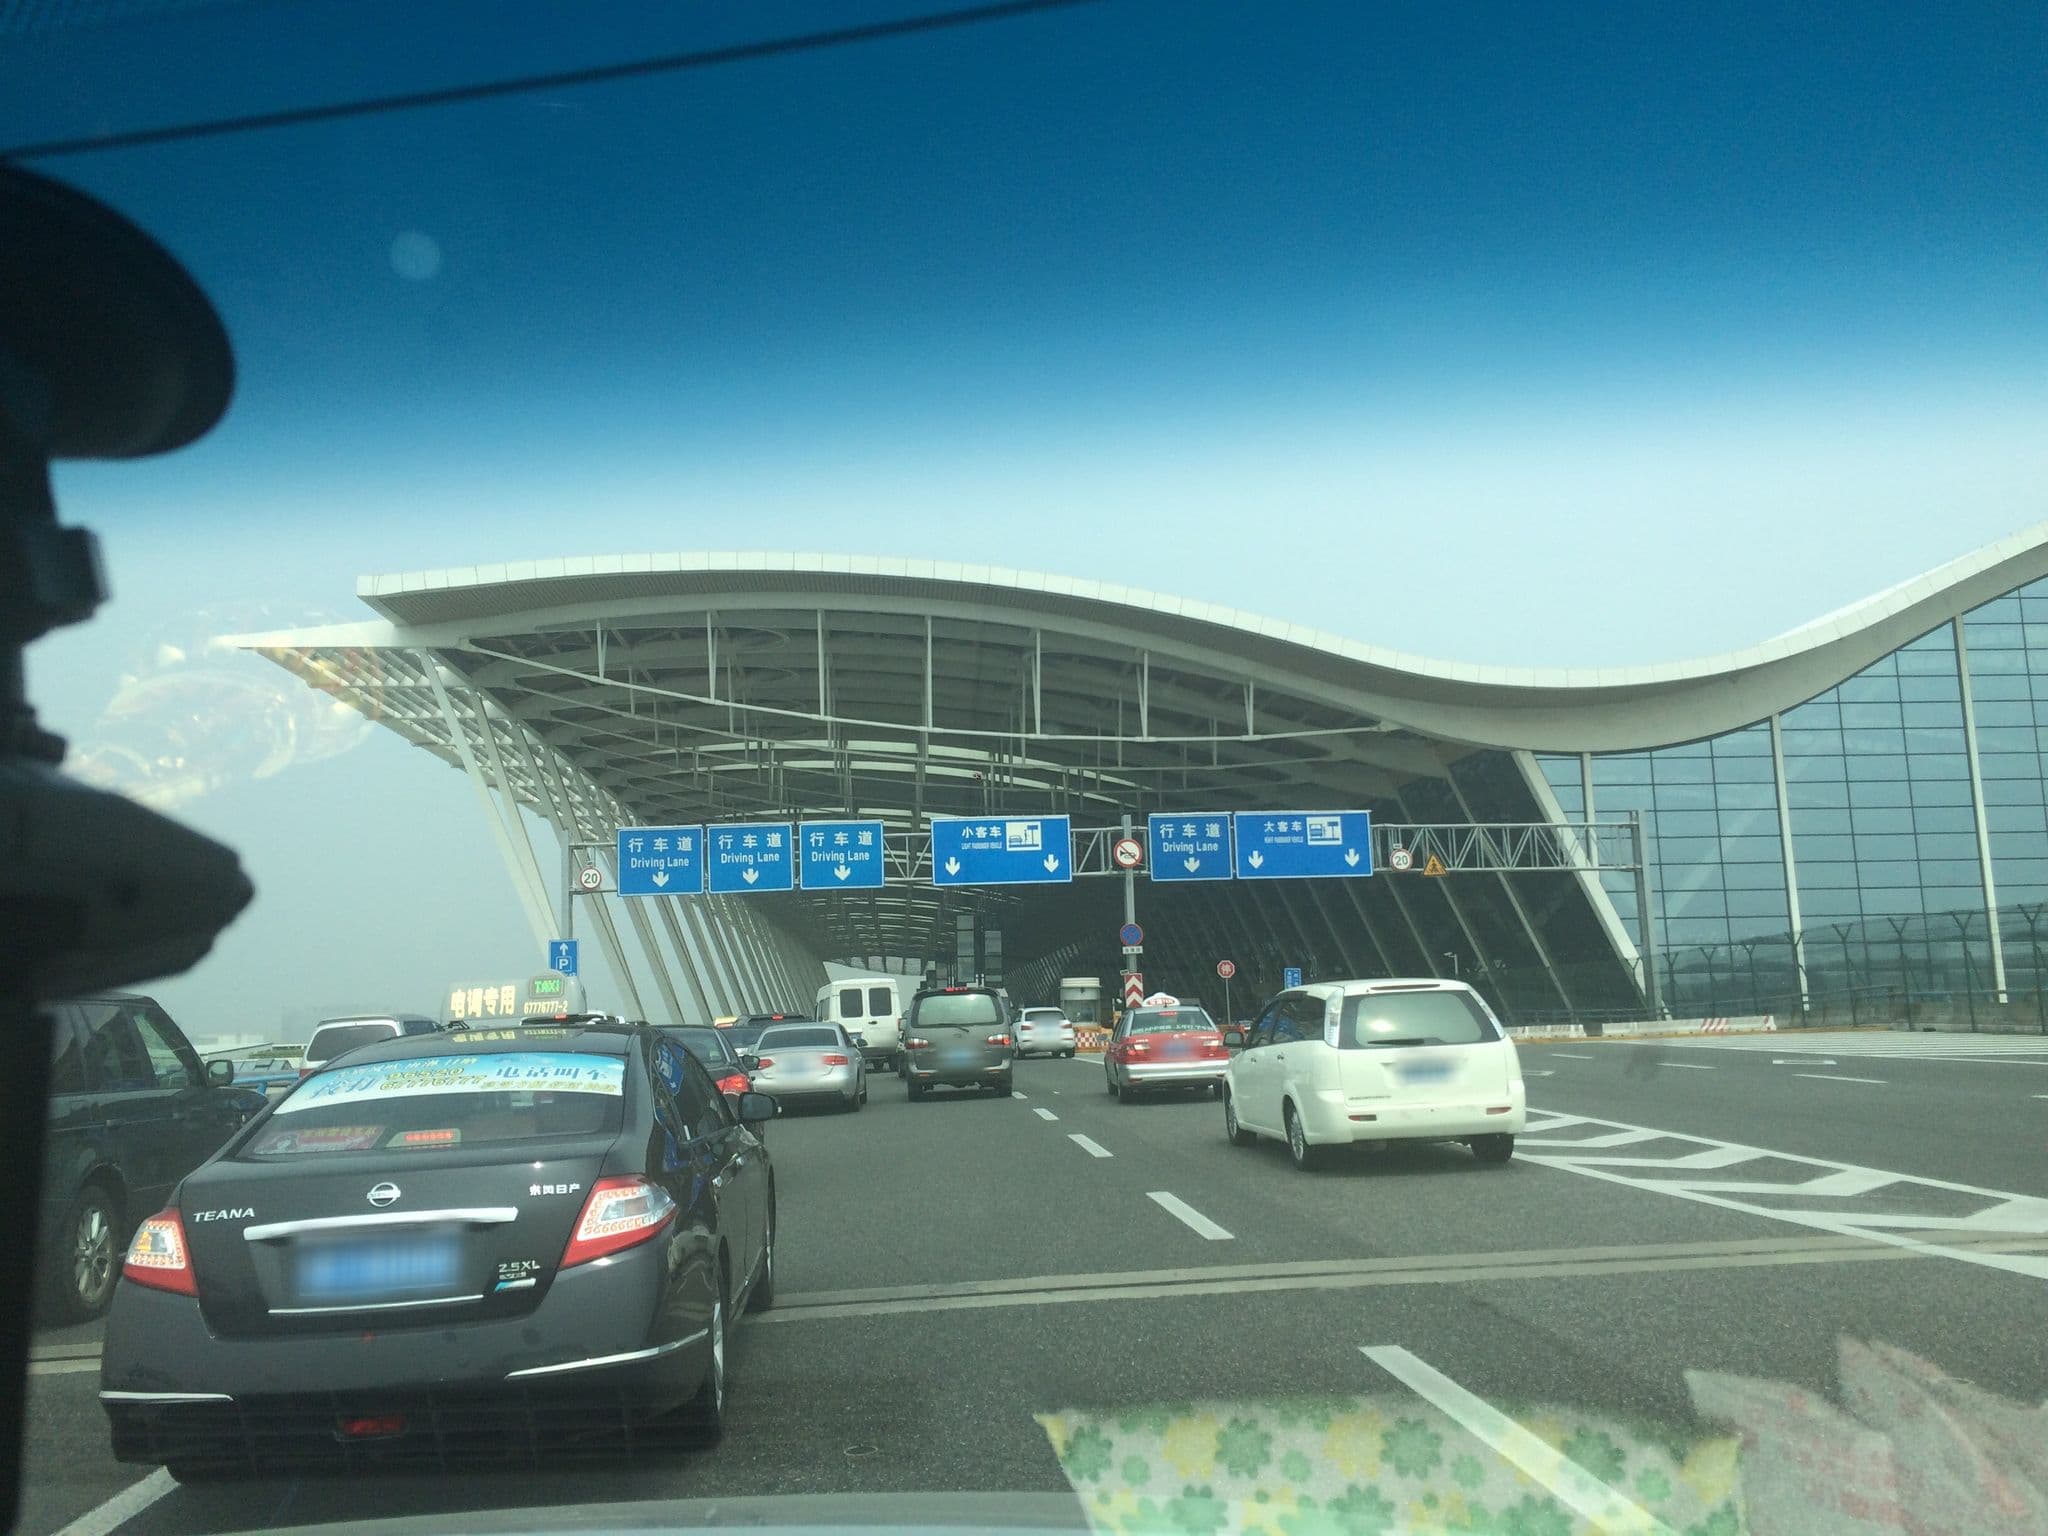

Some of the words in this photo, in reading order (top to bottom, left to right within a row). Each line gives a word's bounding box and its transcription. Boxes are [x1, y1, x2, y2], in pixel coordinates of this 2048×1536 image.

[961, 825, 1002, 838] 小客车
[1159, 822, 1221, 839] 行车道
[1263, 820, 1303, 833] 大客车
[627, 836, 693, 853] 行车道
[718, 832, 782, 850] 行车道
[809, 830, 873, 848] 行车道
[1162, 841, 1194, 855] Driving
[1195, 841, 1219, 852] Lane
[630, 857, 665, 870] Driving
[667, 856, 690, 868] Lane
[720, 852, 754, 865] Driving
[757, 851, 780, 863] Lane
[811, 851, 845, 864] Driving
[847, 850, 870, 861] Lane
[1395, 855, 1409, 866] 20
[583, 872, 598, 884] 20
[558, 958, 569, 970] P
[534, 979, 560, 993] TAXI
[450, 984, 516, 1018] 电调专用
[193, 1207, 256, 1223] TEANA
